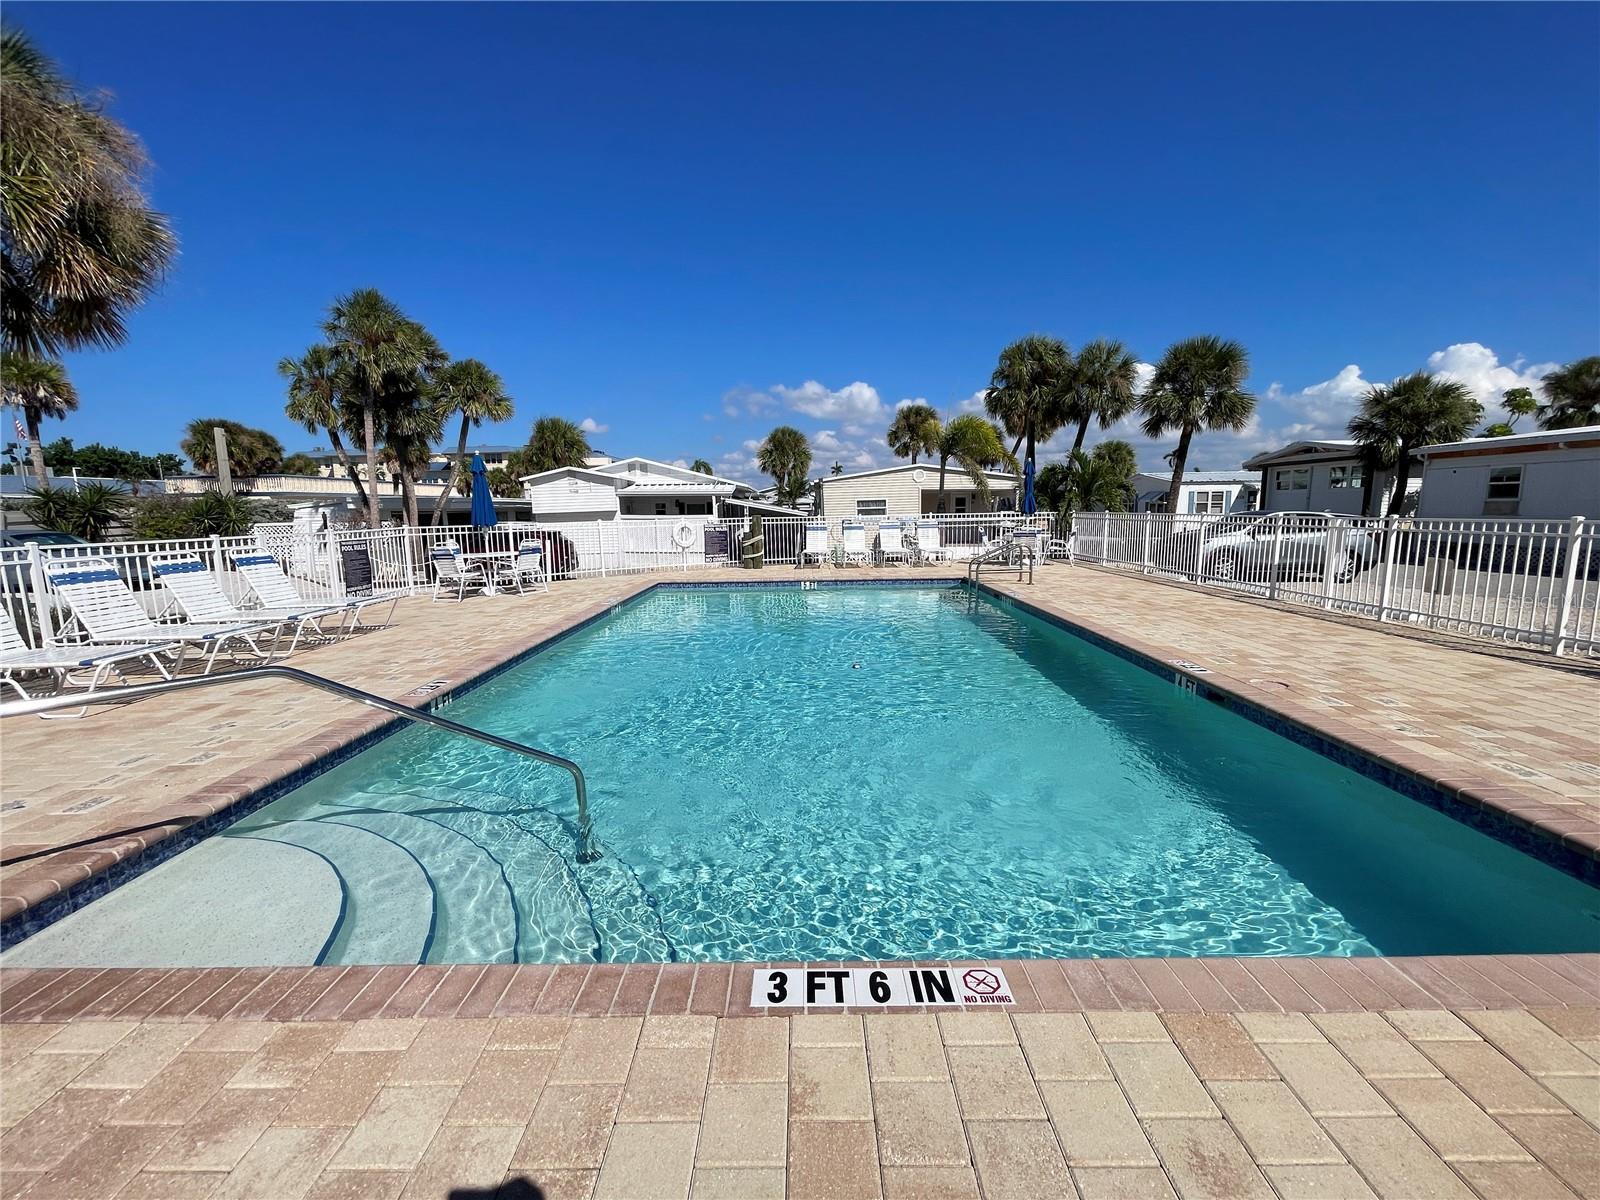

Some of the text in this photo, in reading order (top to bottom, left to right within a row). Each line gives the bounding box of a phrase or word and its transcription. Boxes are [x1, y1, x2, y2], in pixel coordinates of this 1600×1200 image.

[1185, 678, 1196, 694] FT
[767, 970, 956, 1004] 3 FT 6 IN
[963, 995, 1013, 1003] NO DIVING
